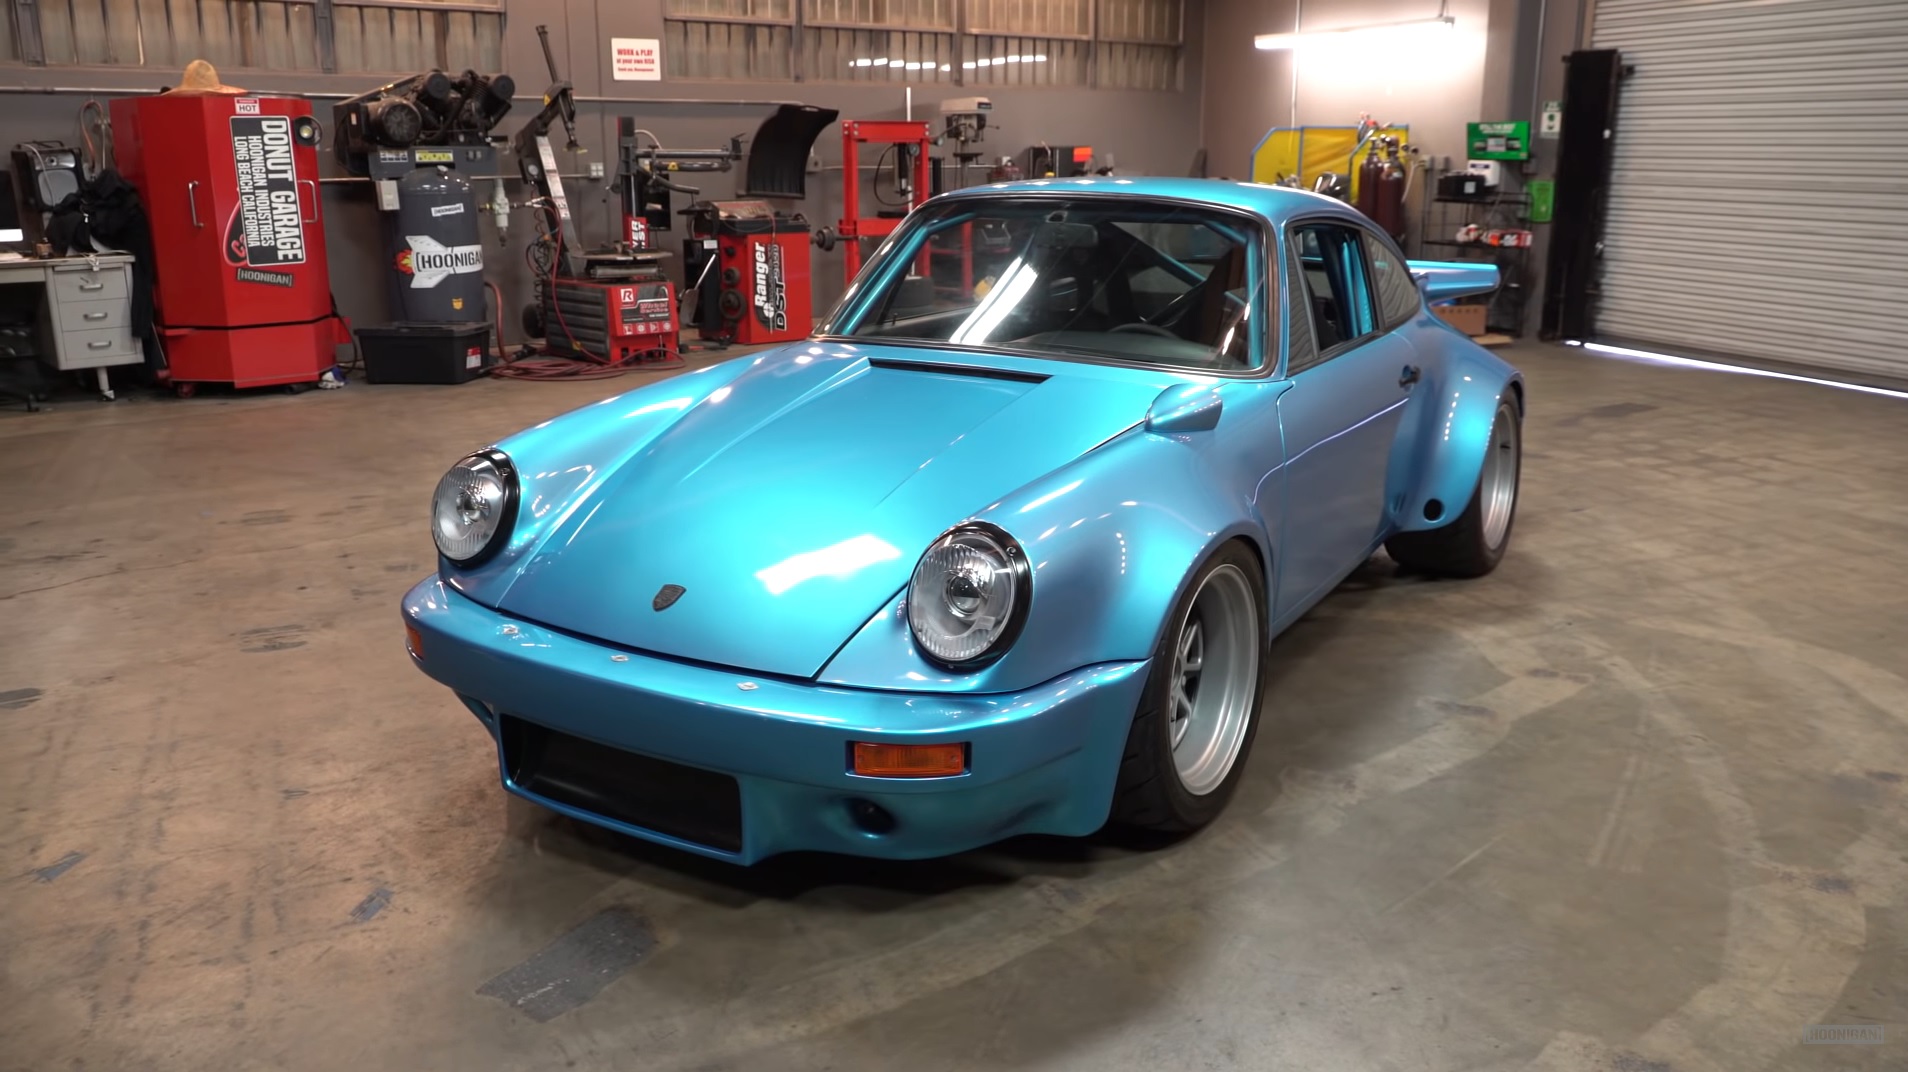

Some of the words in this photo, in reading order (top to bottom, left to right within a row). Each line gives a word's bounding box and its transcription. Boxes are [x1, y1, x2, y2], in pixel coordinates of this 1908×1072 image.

[617, 48, 634, 56] WORK
[239, 104, 257, 112] HOT
[234, 136, 250, 160] LONG
[248, 135, 268, 186] HOONIGAN
[261, 120, 293, 181] DONUT
[237, 162, 254, 192] BEACH
[241, 194, 260, 247] CALIFORNIA
[254, 189, 275, 247] INDUSTRIES
[270, 190, 303, 260] GARAGE
[755, 241, 768, 307] Ranger
[774, 276, 787, 331] DST
